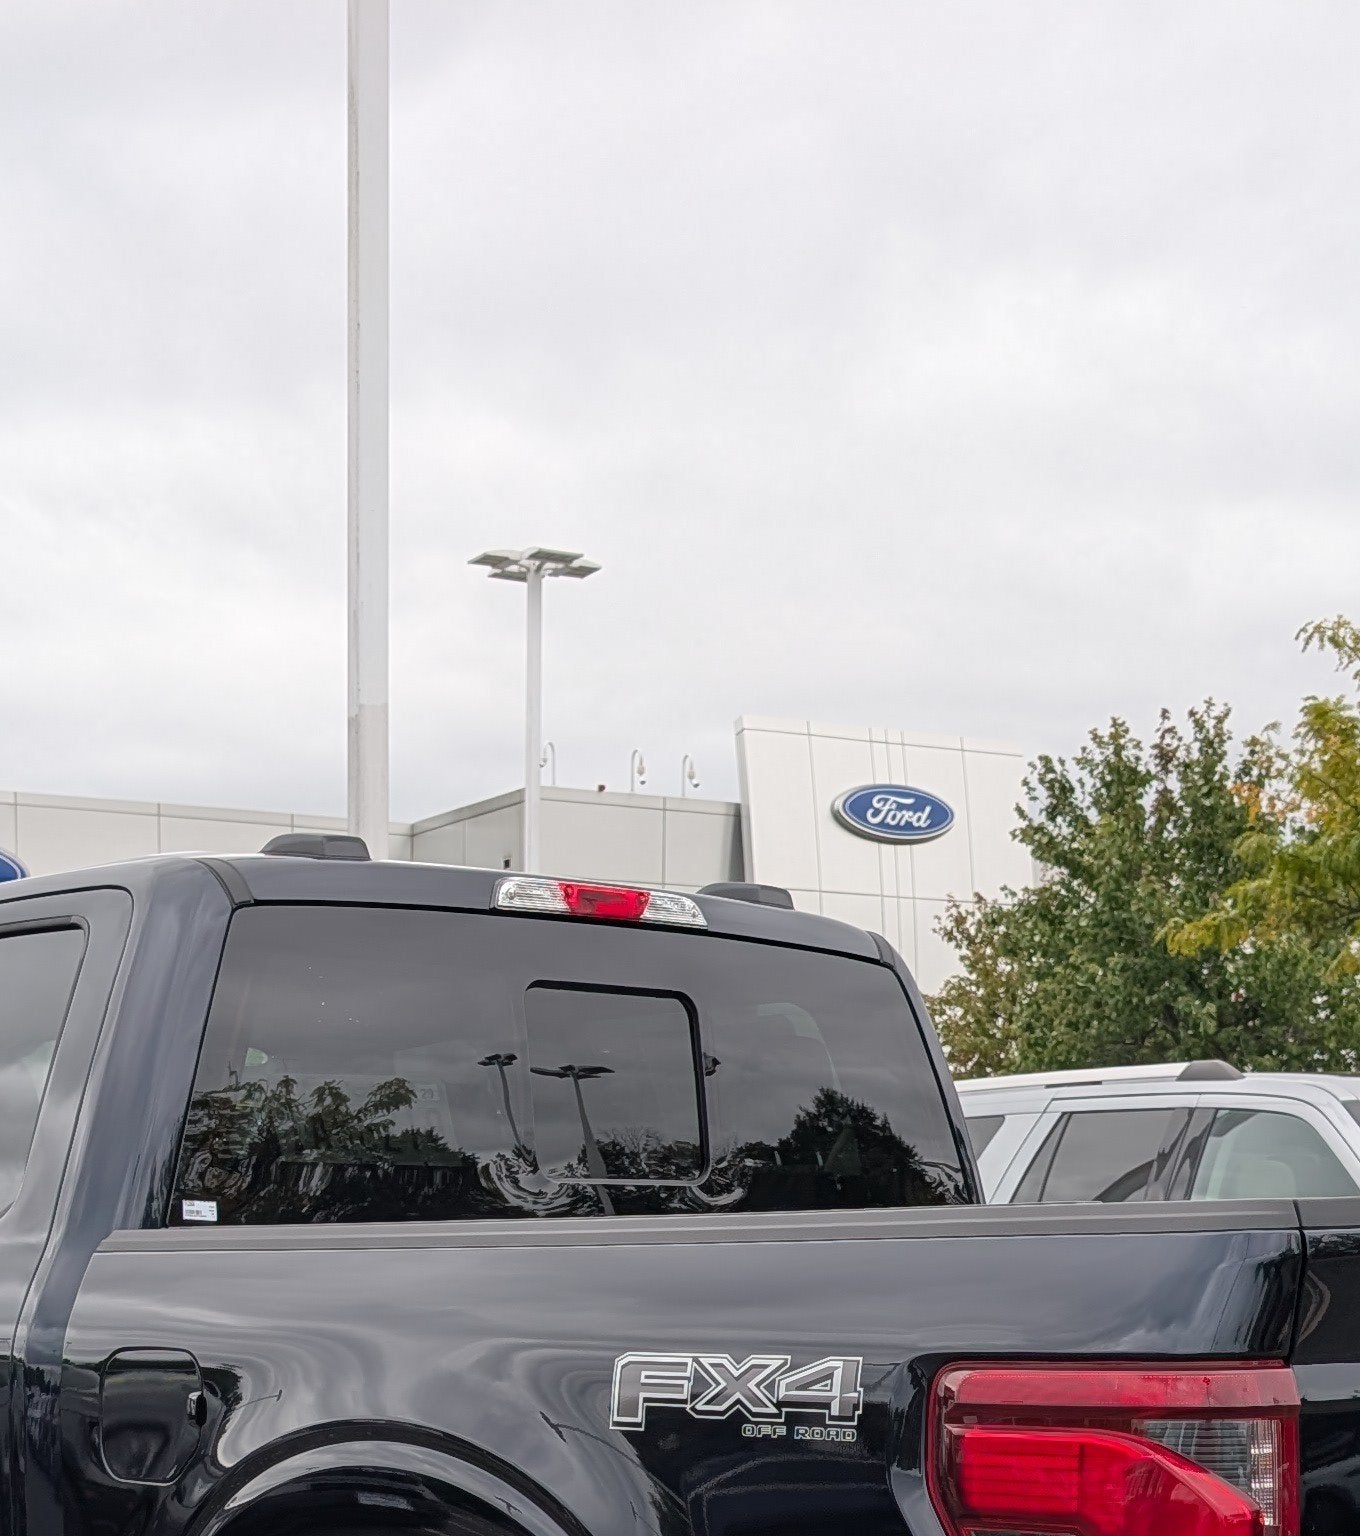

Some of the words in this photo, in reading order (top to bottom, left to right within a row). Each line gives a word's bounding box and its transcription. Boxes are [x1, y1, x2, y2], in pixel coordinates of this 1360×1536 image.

[866, 794, 932, 828] Ford
[609, 1351, 864, 1431] FX4
[741, 1424, 787, 1439] OFF
[793, 1426, 858, 1442] ROAD
